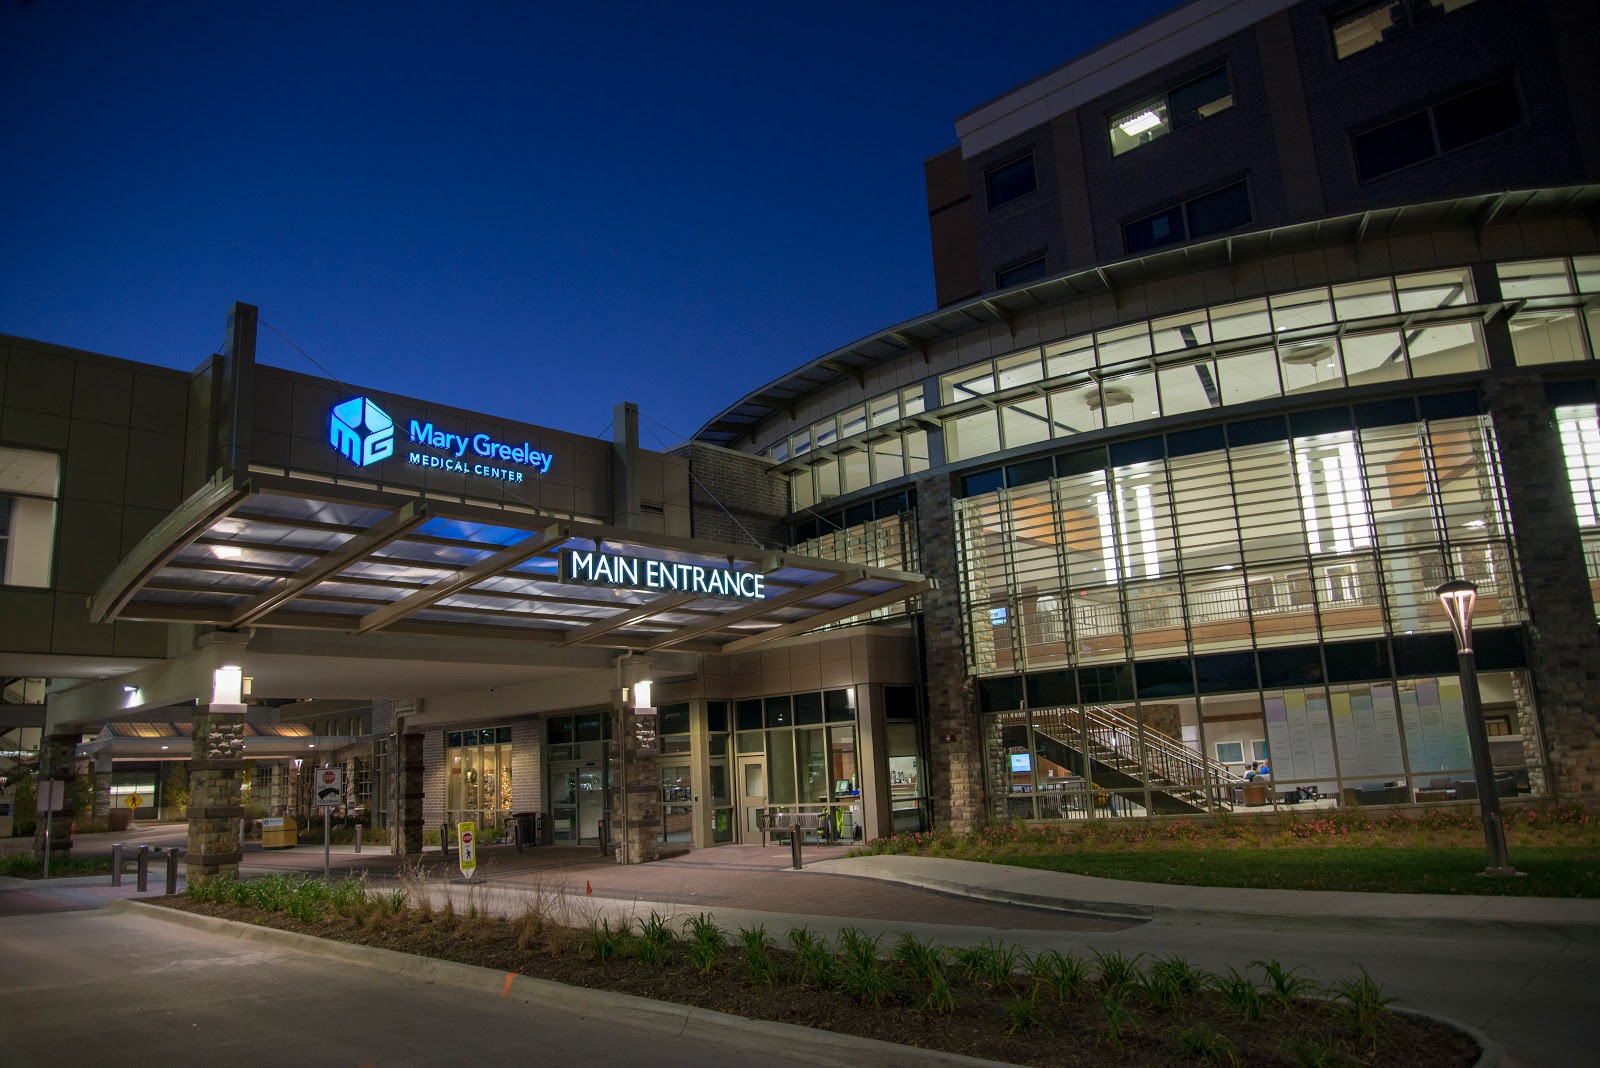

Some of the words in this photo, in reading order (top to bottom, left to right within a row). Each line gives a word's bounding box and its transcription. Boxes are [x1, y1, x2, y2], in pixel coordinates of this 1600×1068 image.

[409, 452, 470, 474] MEDICAL
[474, 464, 523, 483] CENTER
[410, 419, 469, 457] Mary
[473, 433, 553, 474] Greeley
[571, 550, 638, 585] MAIN
[646, 560, 766, 599] ENTRANCE
